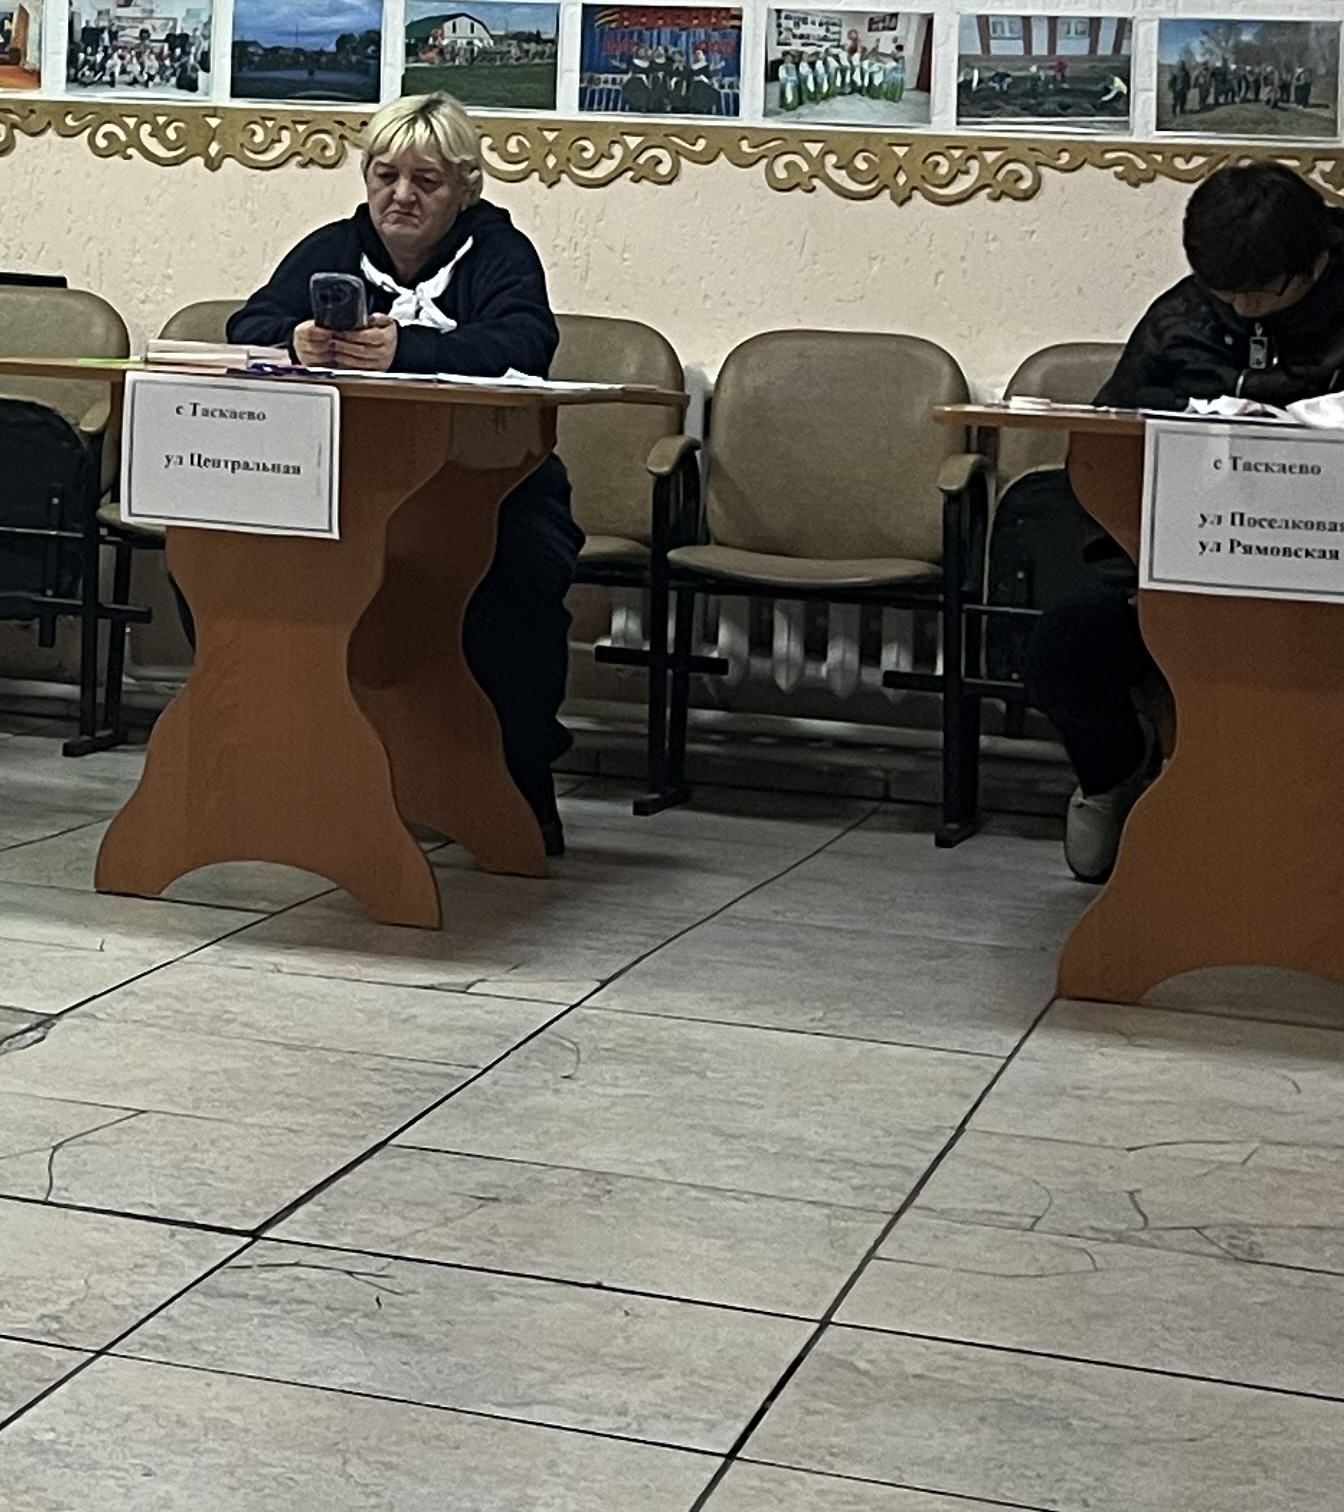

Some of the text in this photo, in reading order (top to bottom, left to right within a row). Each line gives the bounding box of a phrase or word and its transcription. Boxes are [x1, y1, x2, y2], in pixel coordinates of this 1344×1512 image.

[175, 401, 267, 422] с Таскаево
[164, 452, 302, 476] ул Центральная
[1212, 455, 1322, 476] с Таскаево
[1197, 512, 1223, 529] ул
[1197, 538, 1340, 561] ул Рямовская
